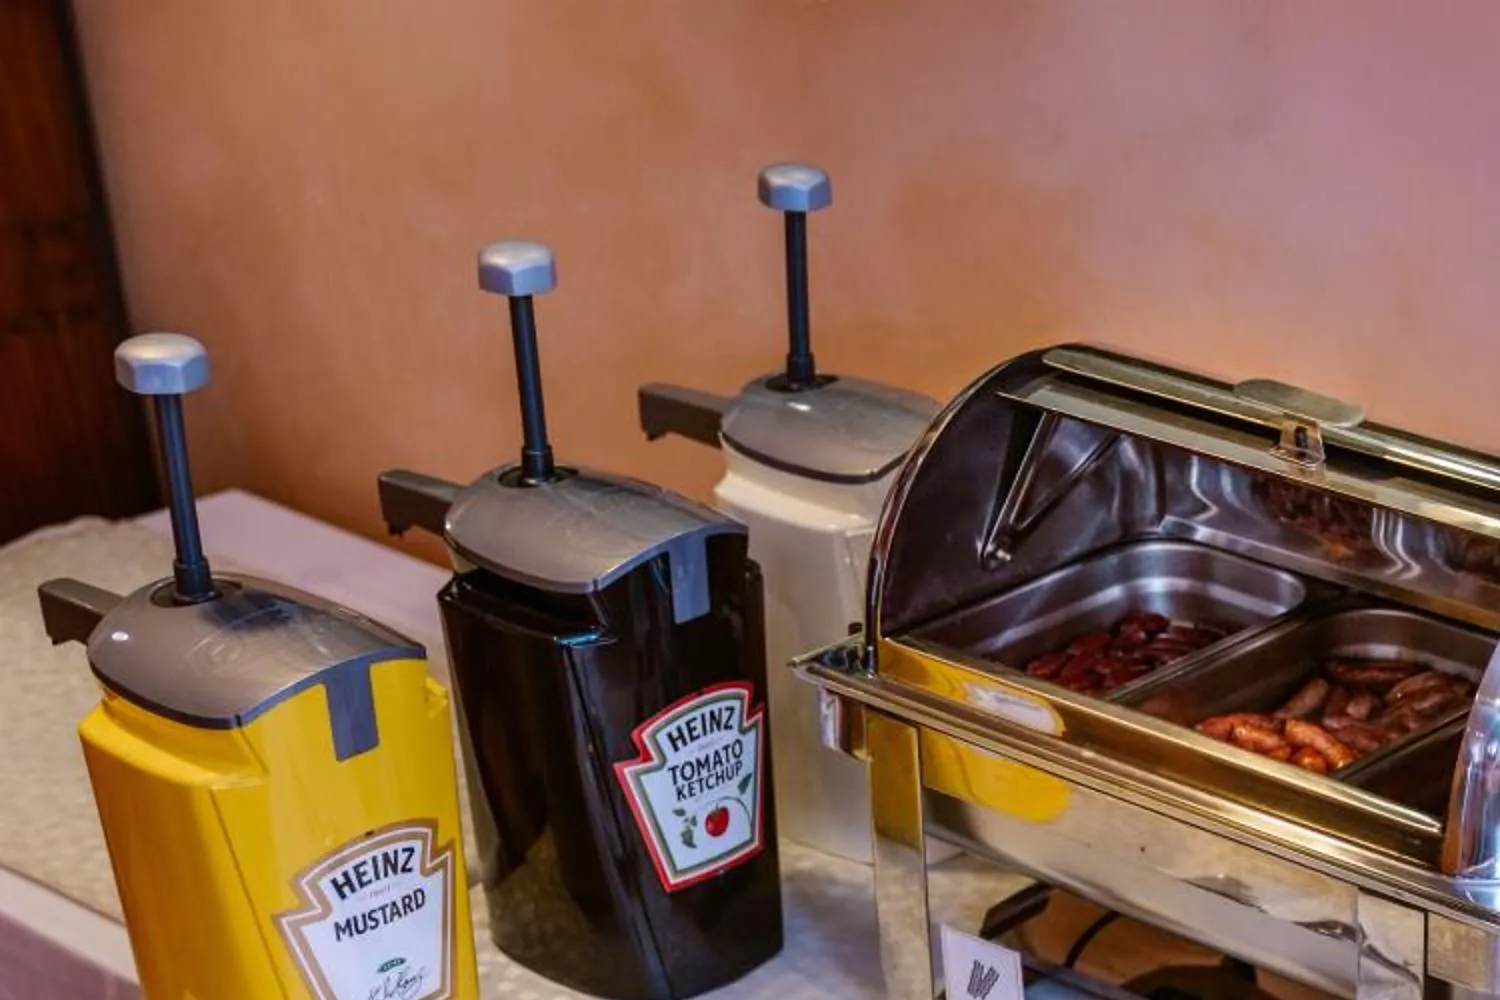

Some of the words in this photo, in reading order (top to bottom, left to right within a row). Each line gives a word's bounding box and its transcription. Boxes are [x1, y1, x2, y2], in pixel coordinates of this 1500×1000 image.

[666, 706, 736, 752] HEINZ
[667, 738, 744, 785] TOMATO
[675, 760, 744, 801] KETCHUP
[330, 847, 416, 900] HEINZ
[333, 887, 426, 942] MUSTARD
